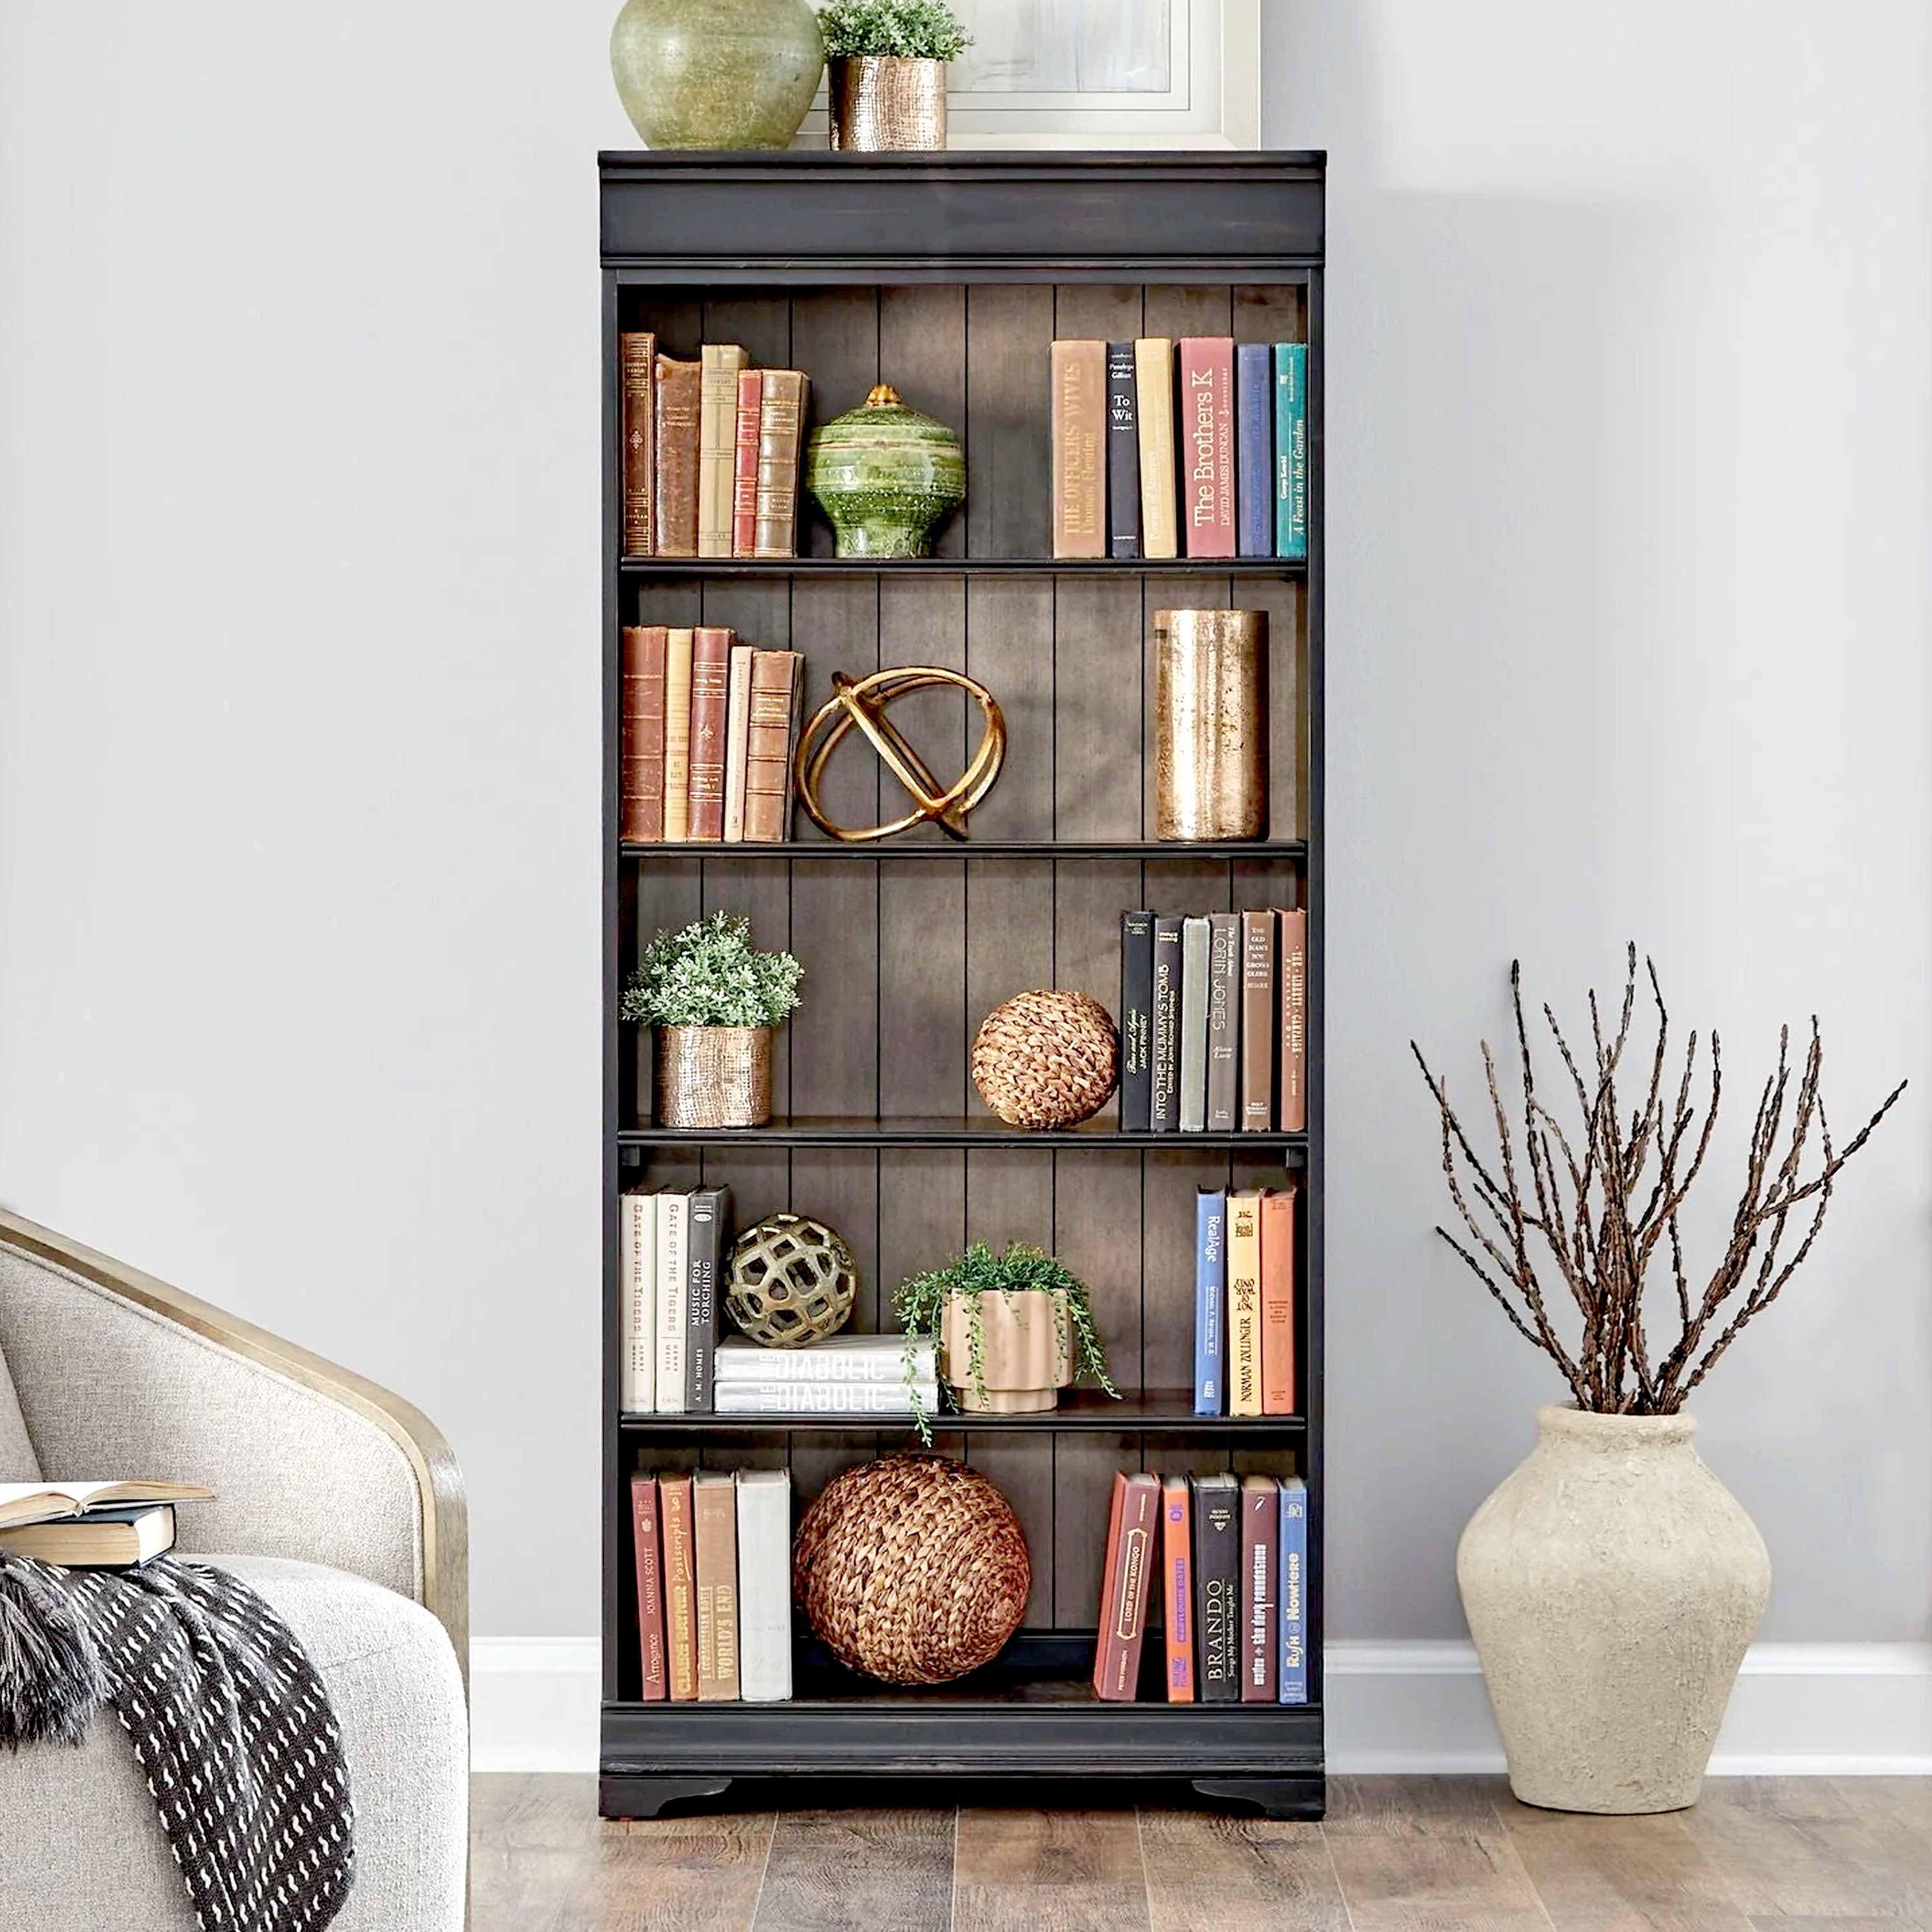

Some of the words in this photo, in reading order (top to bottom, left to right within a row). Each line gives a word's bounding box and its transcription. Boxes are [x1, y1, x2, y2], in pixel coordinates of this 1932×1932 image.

[1065, 362, 1080, 417] WIVES
[1192, 368, 1213, 387] K
[1112, 410, 1132, 421] Wit
[1113, 395, 1130, 406] To
[1193, 393, 1215, 480] Brothers
[1219, 423, 1229, 464] DUNCAN
[1293, 419, 1304, 459] Garden
[1083, 432, 1096, 480] Fleming
[1293, 462, 1303, 480] the
[1220, 465, 1229, 496] JAMES
[1294, 483, 1303, 492] in
[1064, 504, 1080, 536] THE
[1194, 486, 1215, 526] The
[1220, 496, 1230, 526] DAVID
[1294, 495, 1303, 524] Feast
[1213, 928, 1226, 974] LORIN
[1292, 952, 1302, 966] THE
[1158, 964, 1169, 1000] TOMB
[1213, 979, 1226, 1030] JONES
[1158, 1003, 1168, 1061] MUMMY'S
[1157, 1063, 1167, 1089] THE
[1156, 1091, 1166, 1119] INTO
[634, 1205, 643, 1236] GATE
[669, 1204, 679, 1236] GATE
[634, 1242, 641, 1256] OF
[668, 1242, 677, 1255] OF
[1206, 1216, 1220, 1263] RealAge
[692, 1260, 701, 1283] FOR
[1234, 1279, 1255, 1290] ONLY
[692, 1289, 701, 1326] MUSIC
[701, 1262, 711, 1324] TORCHING
[1236, 1302, 1253, 1311] NOT
[634, 1287, 643, 1332] TIGERS
[668, 1287, 678, 1332] TIGERS
[1240, 1318, 1251, 1362] ZOLLINGER
[775, 1354, 885, 1380] DIABOLIC
[777, 1385, 886, 1411] DIABOLIC
[1240, 1366, 1251, 1401] NORMAN
[644, 1547, 654, 1575] SCOTT
[669, 1517, 687, 1581] Postscripts
[1130, 1546, 1140, 1577] KONGO
[647, 1578, 655, 1616] JOANNA
[717, 1585, 732, 1612] END
[1128, 1591, 1133, 1600] OF
[1124, 1601, 1133, 1622] LORD
[1207, 1580, 1222, 1680] BRANDO
[647, 1633, 660, 1684] Arrogance
[717, 1620, 734, 1679] WORLD'S
